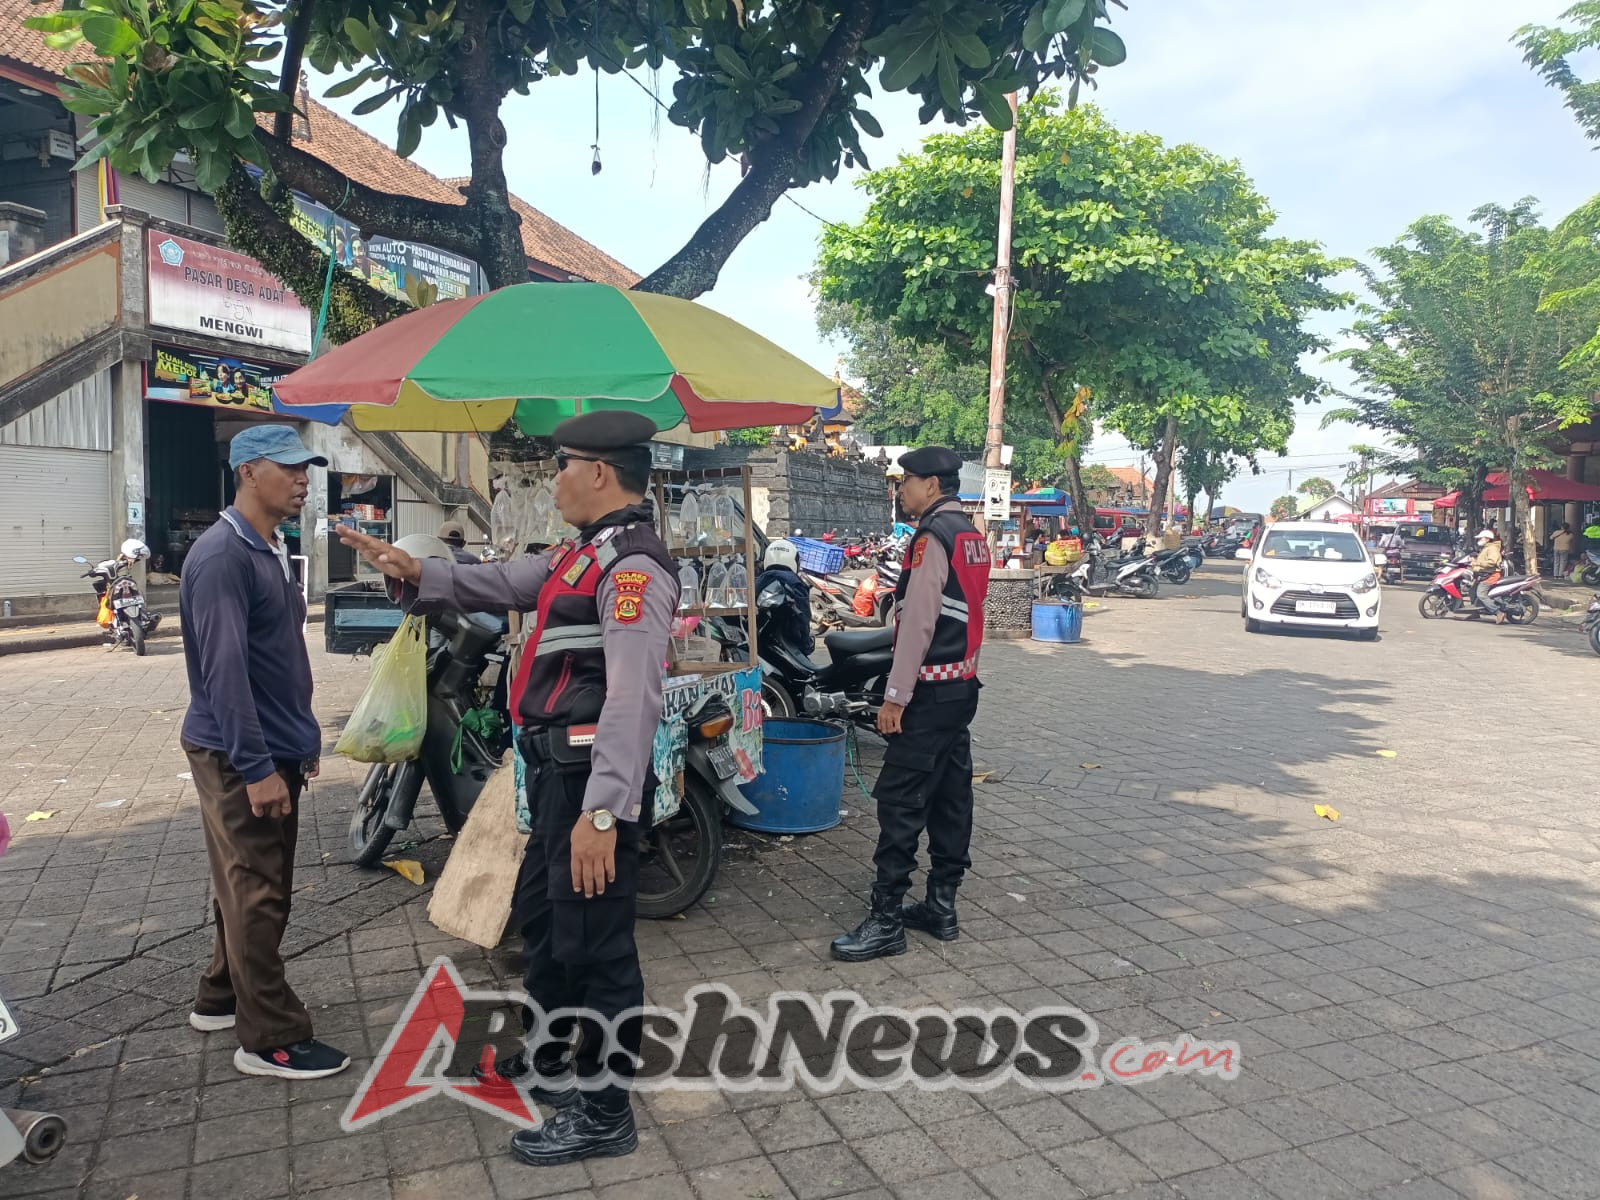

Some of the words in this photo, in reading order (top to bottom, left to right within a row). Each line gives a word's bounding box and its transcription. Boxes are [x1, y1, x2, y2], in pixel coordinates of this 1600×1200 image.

[382, 241, 407, 254] AUTO
[411, 244, 439, 262] PASTIKAN
[412, 258, 429, 272] ANDA
[184, 266, 223, 289] PASAR
[226, 277, 255, 297] DESA
[258, 287, 285, 304] ADAT
[200, 316, 263, 339] MENGWI
[156, 349, 183, 366] KUAH
[156, 358, 198, 378] MEDOK
[615, 572, 648, 582] POLRES
